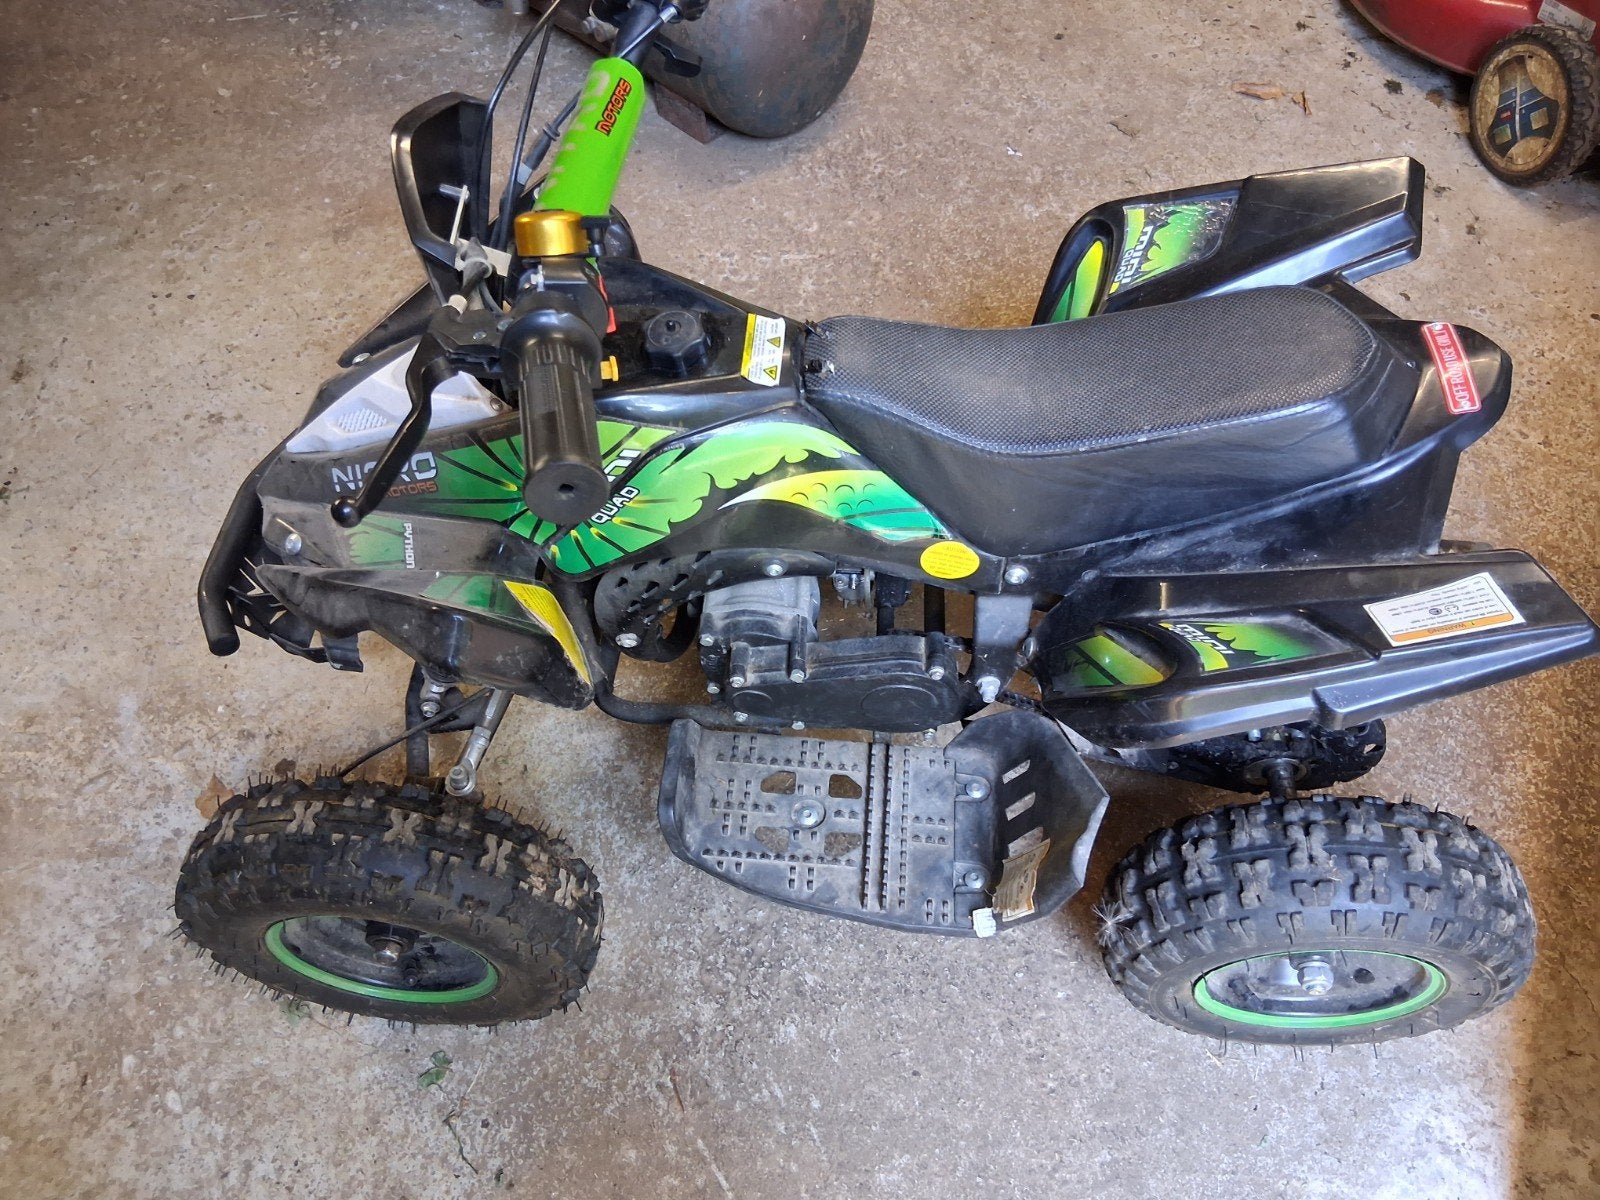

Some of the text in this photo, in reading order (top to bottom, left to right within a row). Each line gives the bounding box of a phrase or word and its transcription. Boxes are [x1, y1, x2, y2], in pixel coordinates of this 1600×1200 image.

[595, 78, 632, 137] MOTORS
[1113, 249, 1135, 283] QUAD
[1433, 329, 1470, 402] OFF ROAD USE ONLY
[590, 486, 640, 524] QUAD
[403, 522, 415, 569] PYTHON
